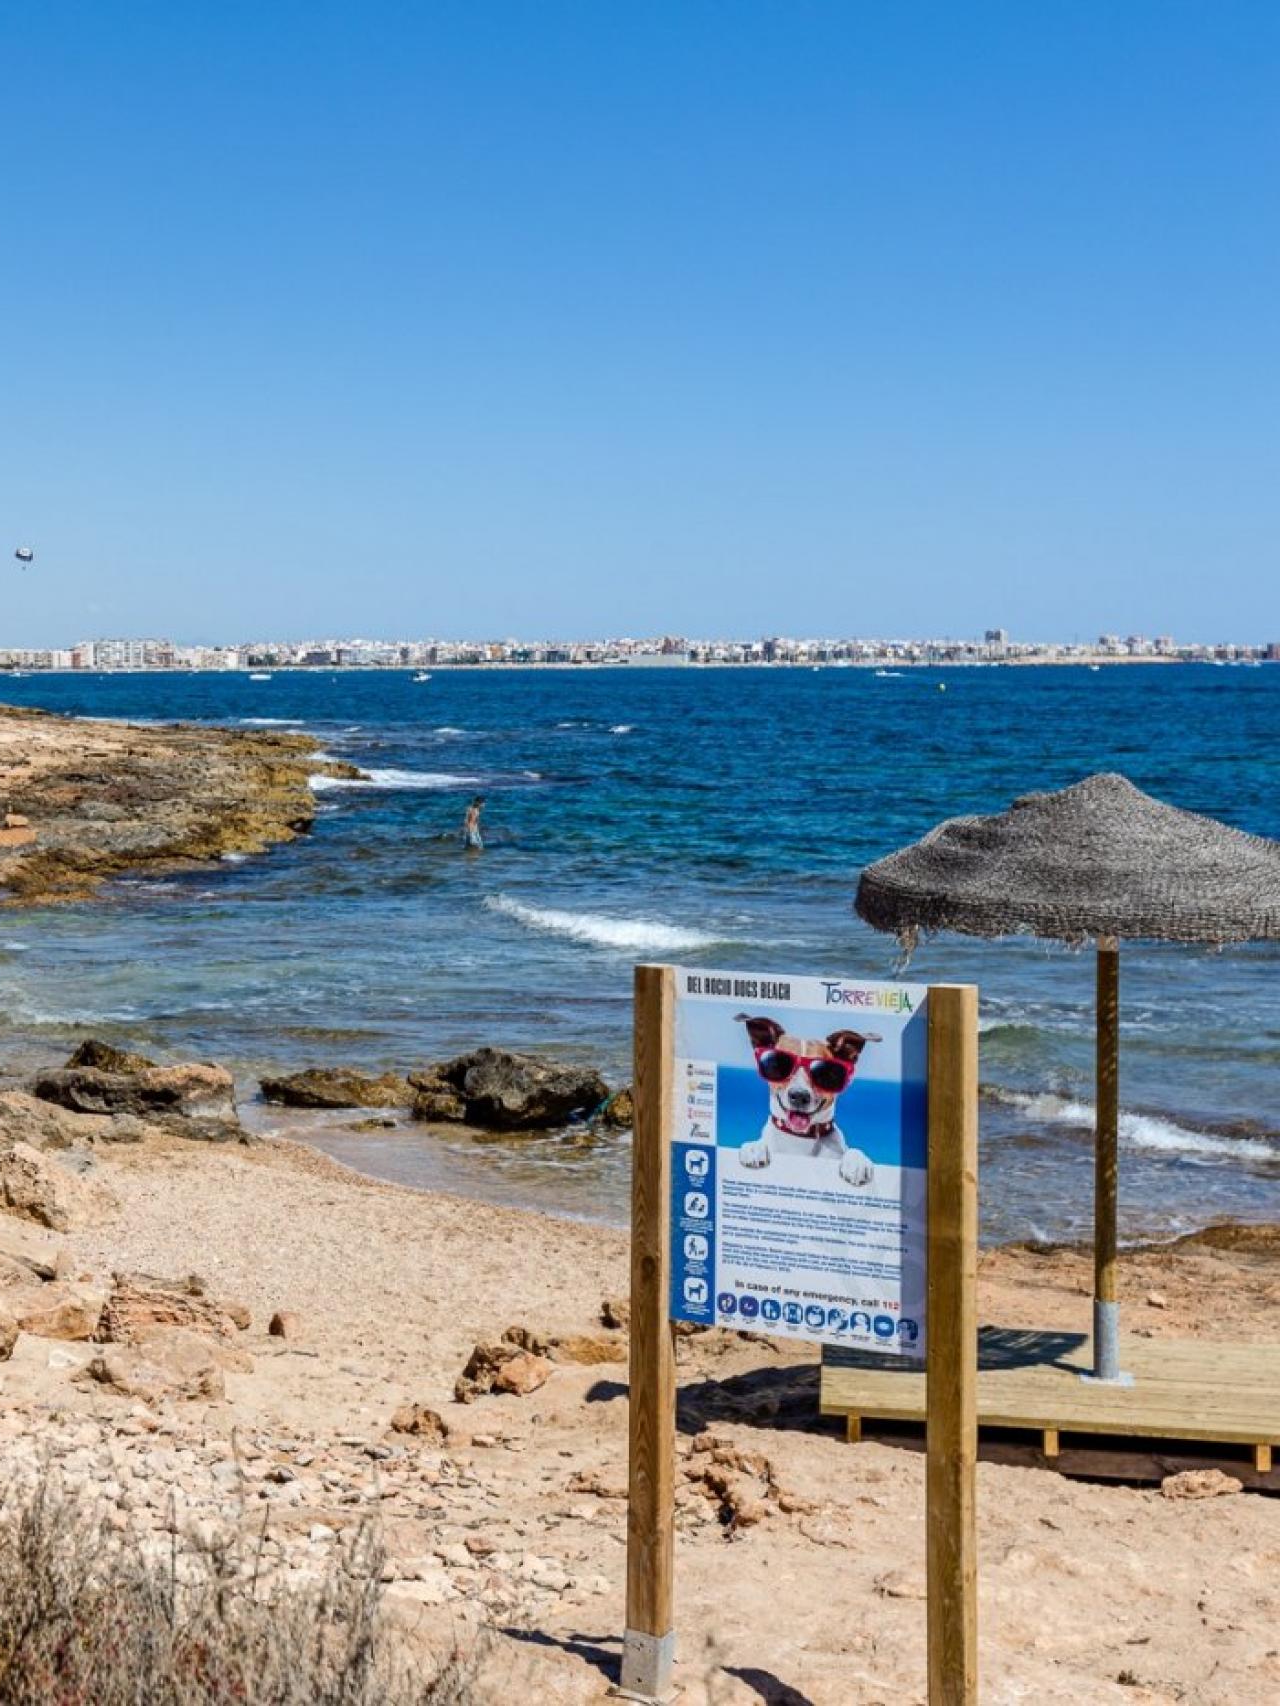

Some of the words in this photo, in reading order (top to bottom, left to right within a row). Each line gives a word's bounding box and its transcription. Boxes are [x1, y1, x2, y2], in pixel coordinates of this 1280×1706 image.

[687, 976, 702, 993] DEL
[734, 979, 758, 998] DOGS
[760, 981, 791, 1001] BEACH
[820, 981, 913, 1013] TORREVIEJA
[734, 1279, 745, 1288] In
[746, 1283, 769, 1292] case
[770, 1285, 781, 1294] of
[783, 1288, 800, 1298] any
[860, 1298, 880, 1308] call
[882, 1301, 900, 1310] 112
